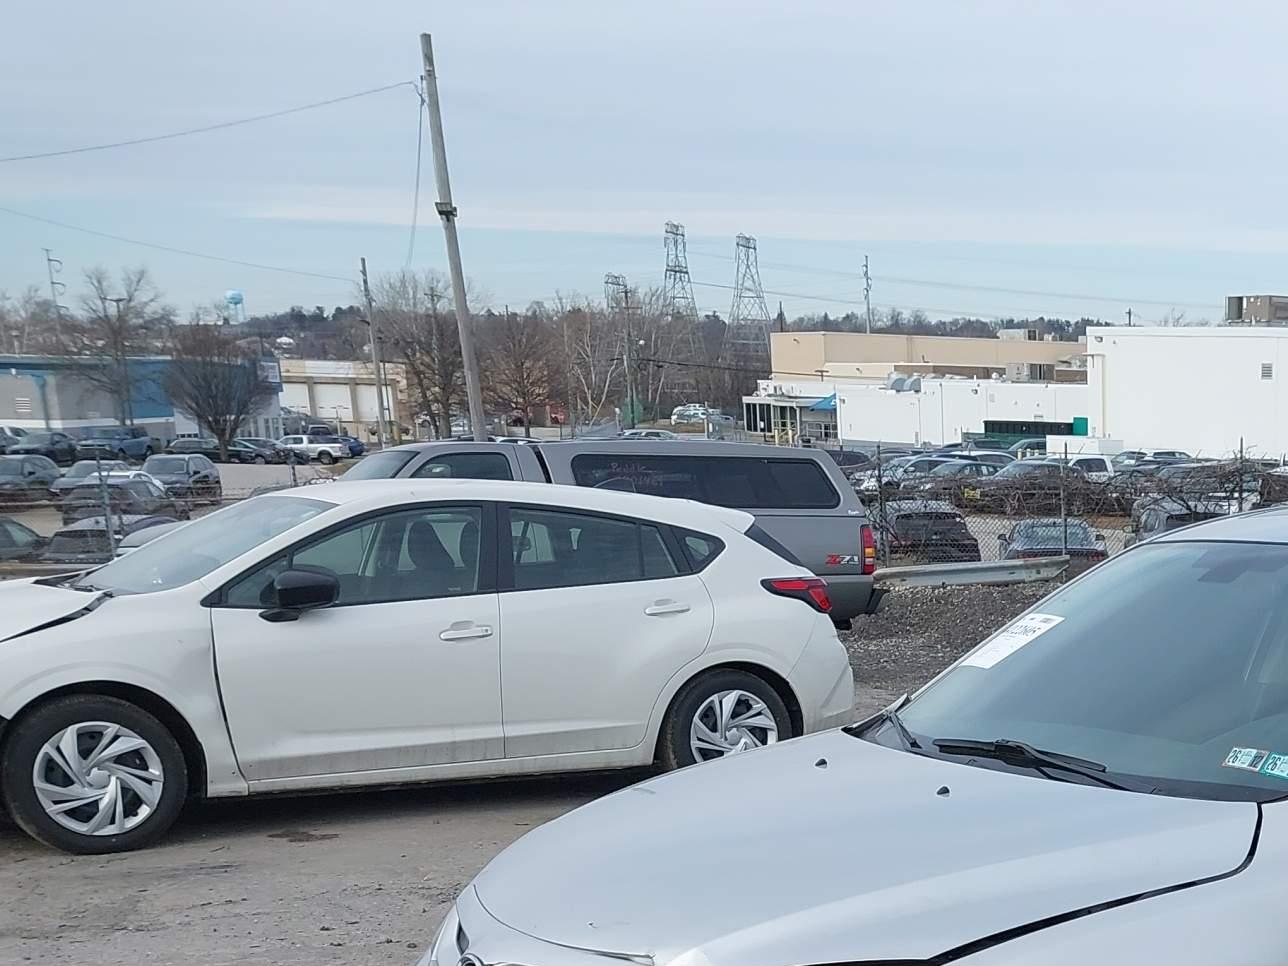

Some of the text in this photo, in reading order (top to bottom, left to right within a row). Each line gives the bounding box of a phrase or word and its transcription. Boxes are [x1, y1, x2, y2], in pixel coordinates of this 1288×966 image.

[825, 555, 860, 565] Z71
[1227, 748, 1241, 764] 26
[1249, 755, 1265, 769] 12
[1266, 756, 1281, 771] 26
